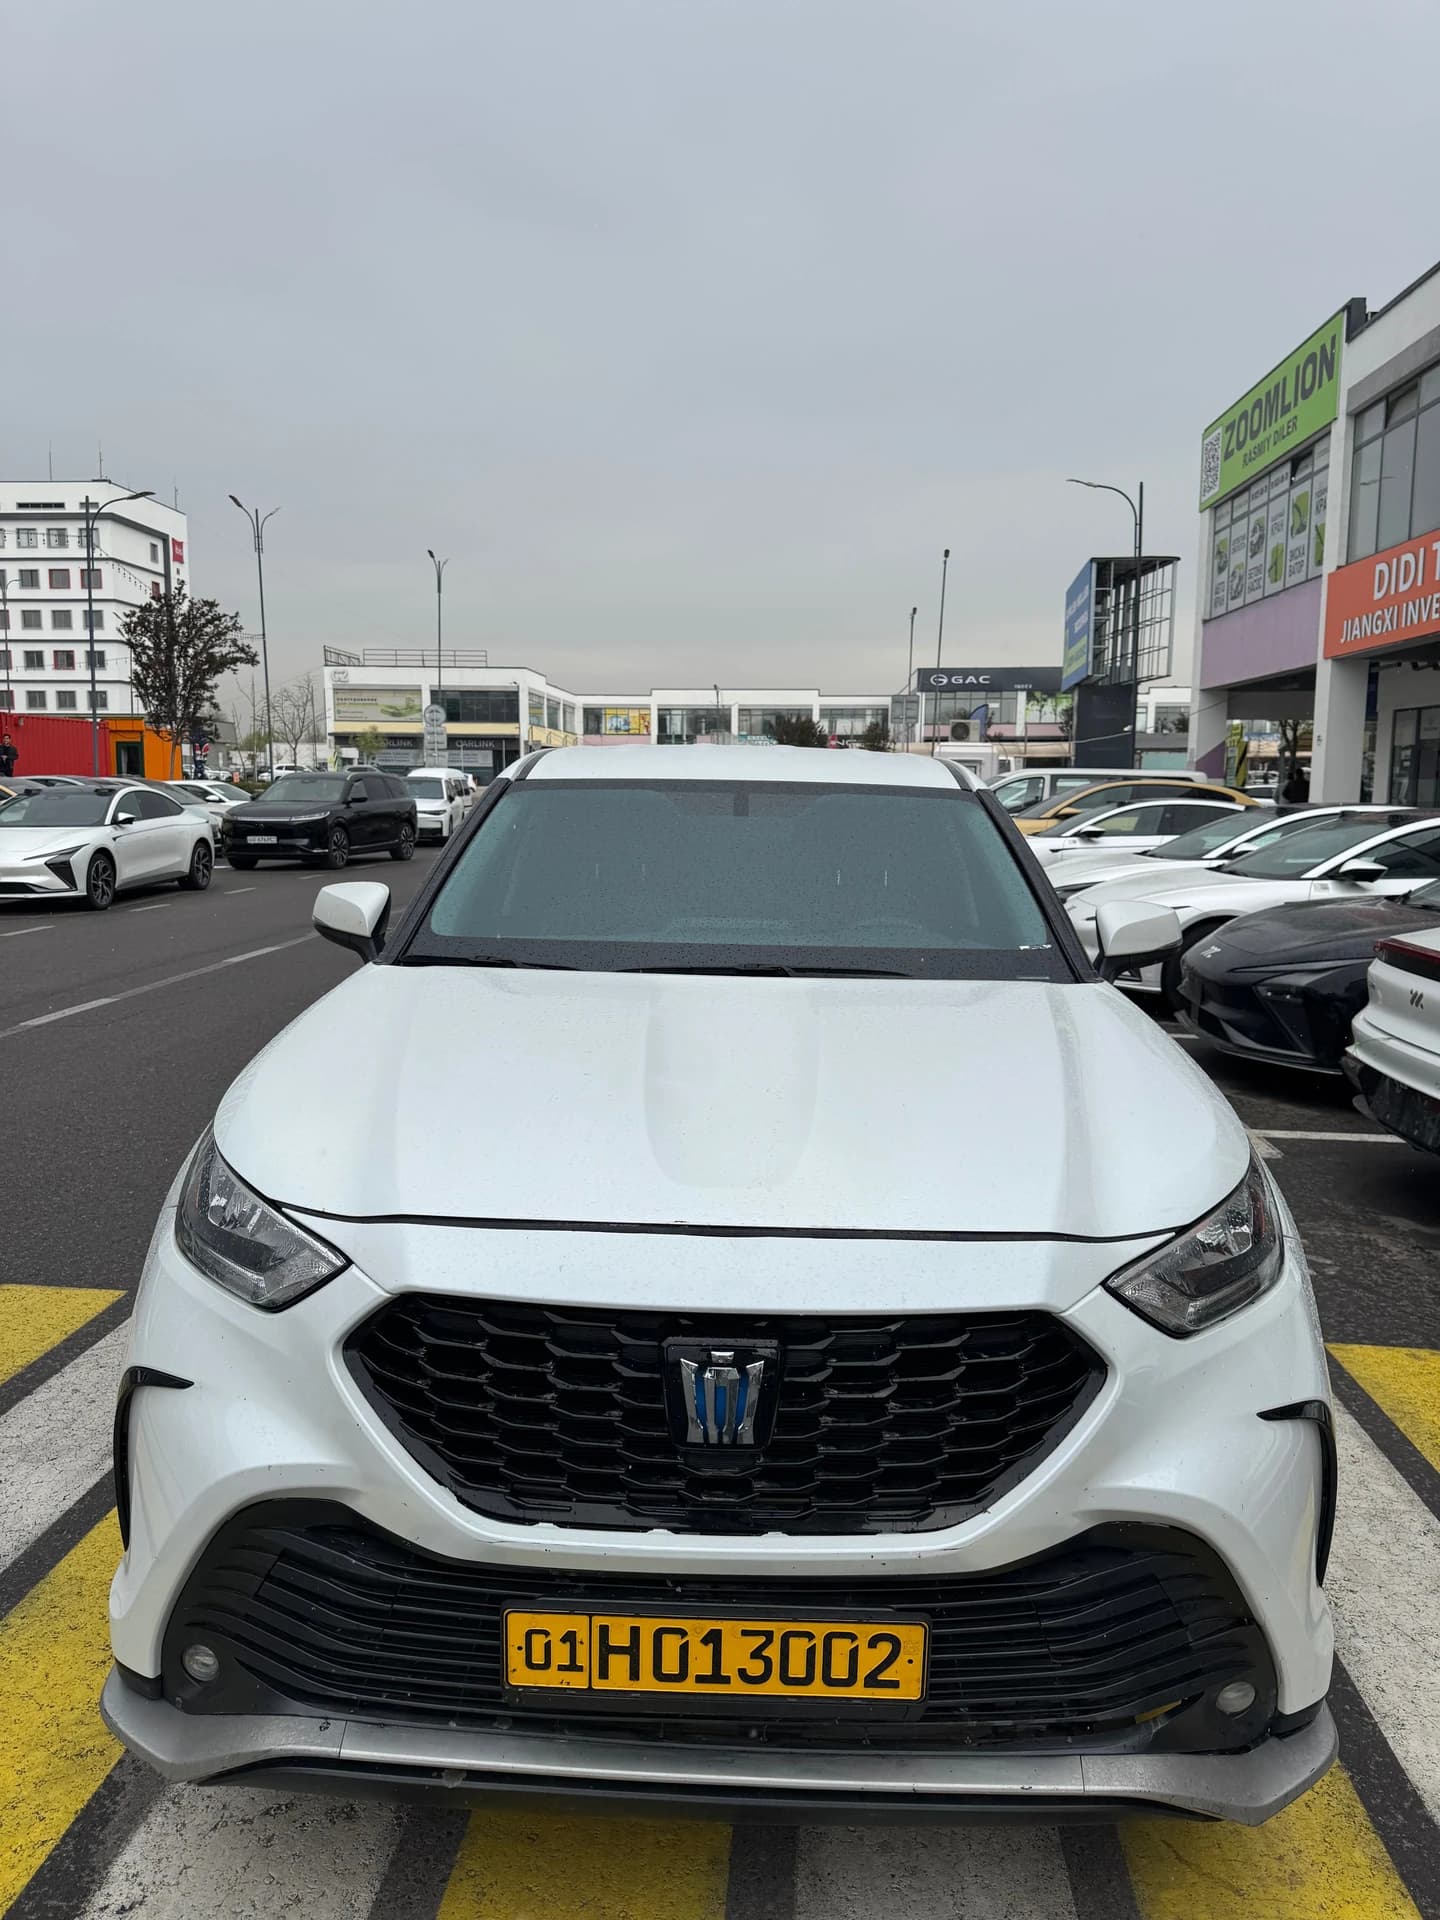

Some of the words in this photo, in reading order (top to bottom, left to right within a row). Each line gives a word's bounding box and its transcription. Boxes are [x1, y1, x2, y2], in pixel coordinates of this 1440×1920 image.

[1223, 334, 1337, 462] ZOOMLION
[1242, 434, 1272, 468] RASMIY
[1273, 416, 1298, 446] DILER
[1373, 547, 1425, 601] DIDI
[1340, 605, 1398, 643] JIANGXI
[951, 675, 991, 684] GAC
[525, 1629, 584, 1672] 01
[598, 1624, 901, 1689] H013002
